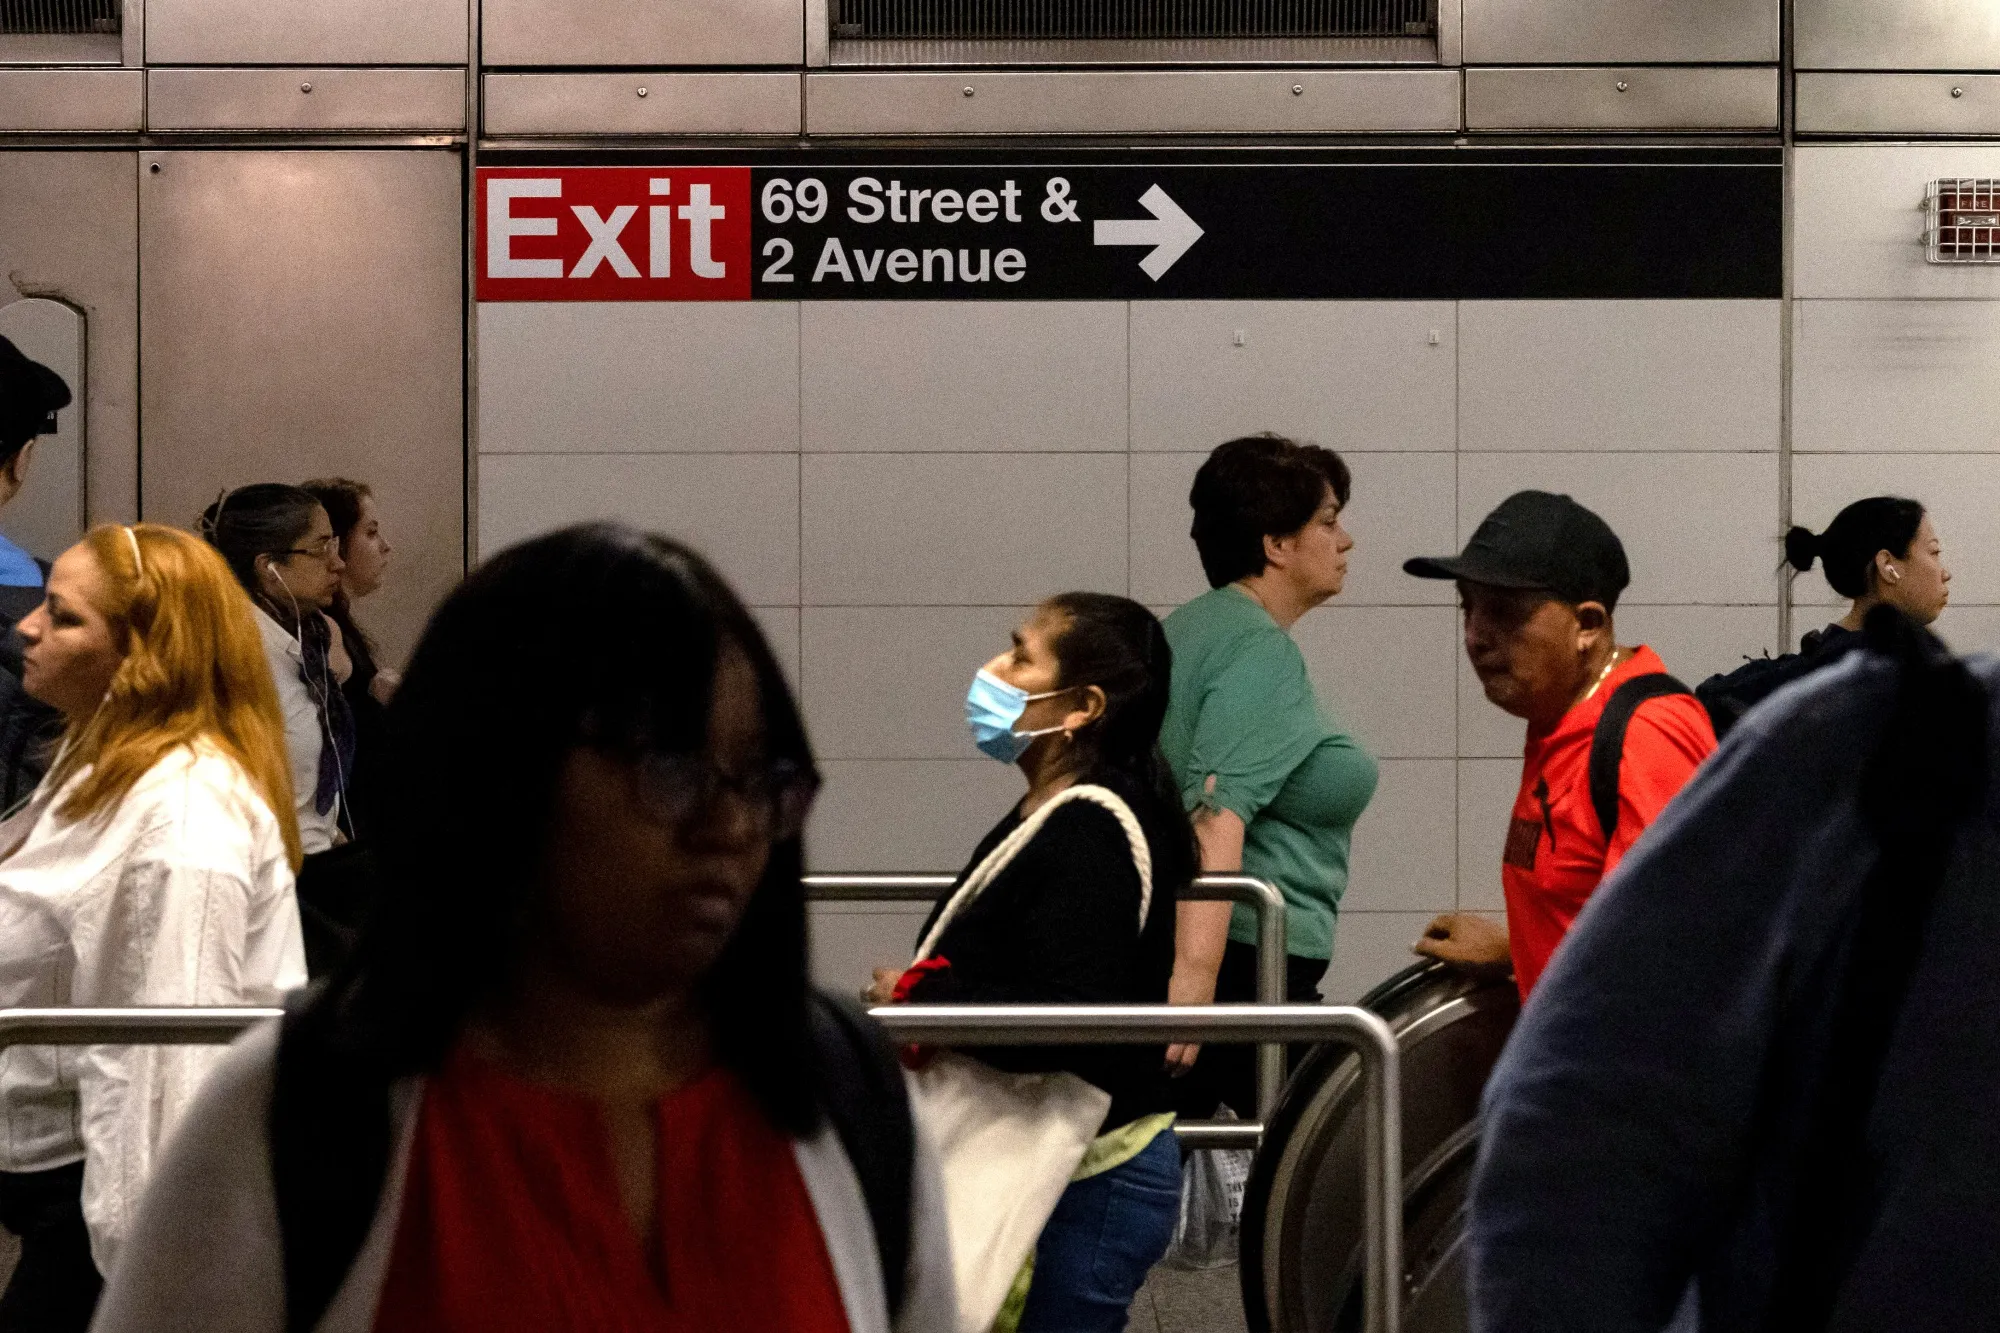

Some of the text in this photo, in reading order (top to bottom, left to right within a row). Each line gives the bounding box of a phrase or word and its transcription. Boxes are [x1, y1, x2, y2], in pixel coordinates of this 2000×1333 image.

[761, 176, 1082, 224] 69 Street &
[1961, 200, 1988, 208] FIRE
[487, 178, 726, 279] Exit
[761, 237, 1027, 283] 2 Avenue
